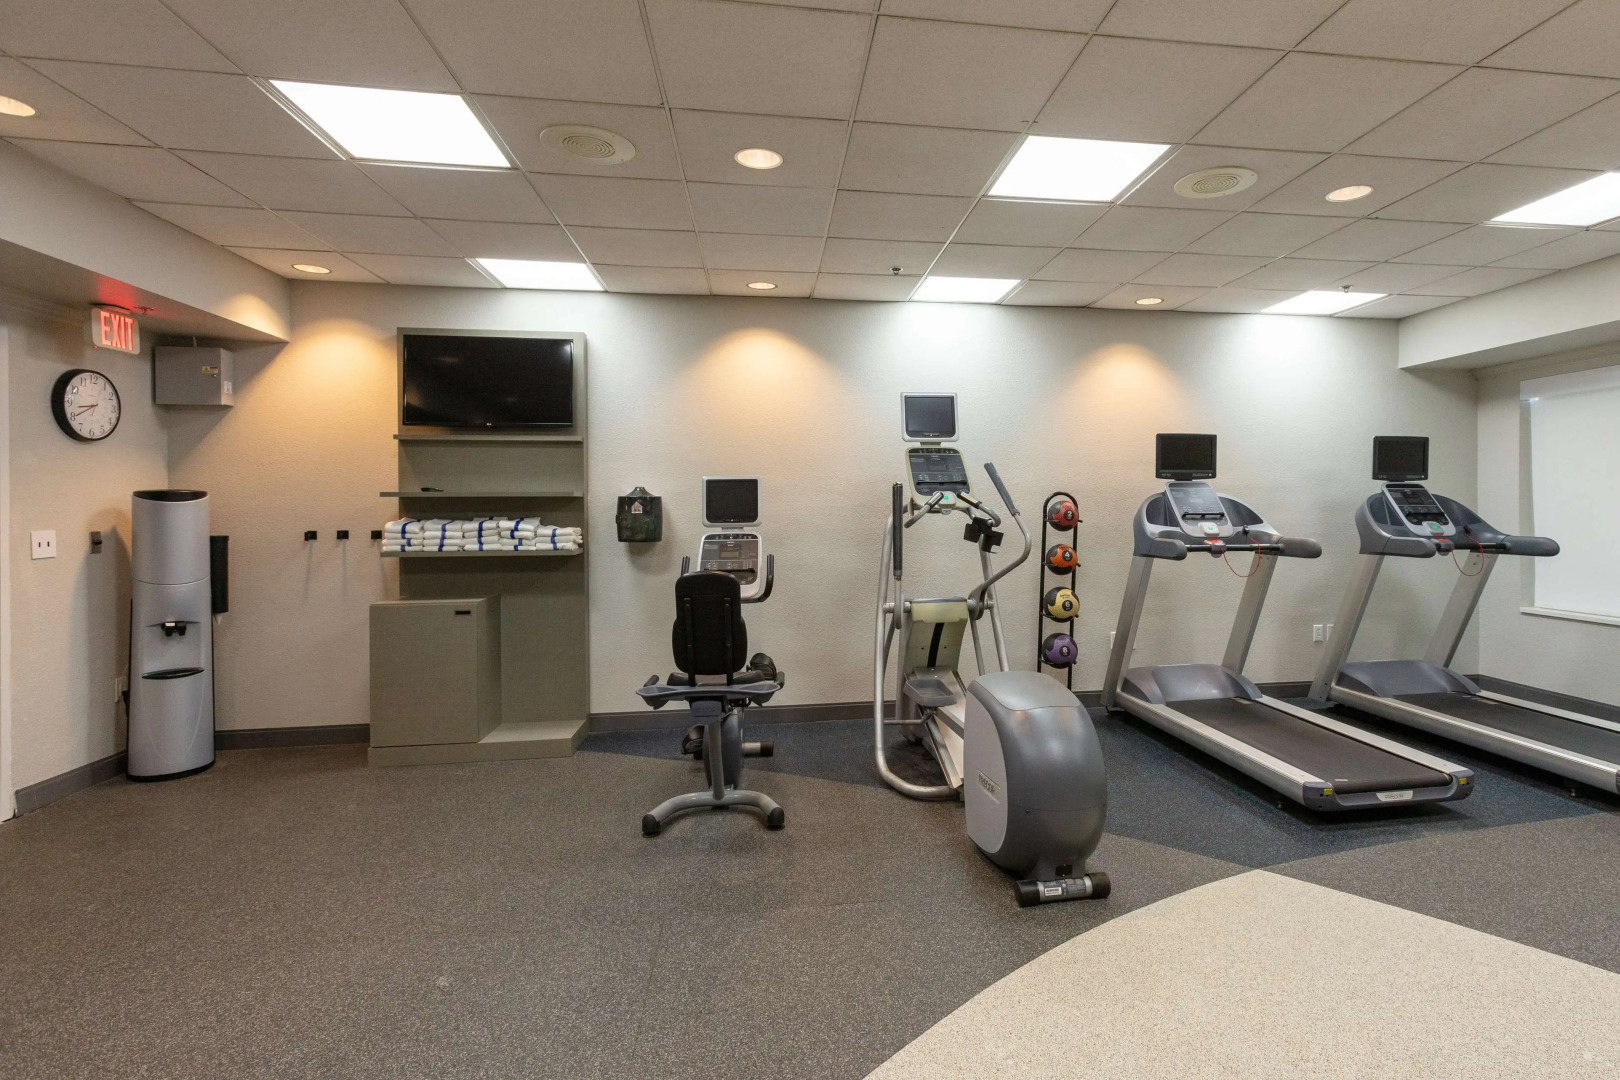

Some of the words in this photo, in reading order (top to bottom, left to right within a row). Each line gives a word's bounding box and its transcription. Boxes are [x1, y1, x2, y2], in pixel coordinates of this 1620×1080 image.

[100, 310, 134, 351] EXIT
[80, 377, 87, 388] 11
[89, 374, 99, 385] 12
[71, 384, 79, 395] 10
[103, 382, 107, 391] 1
[108, 391, 114, 401] 2
[111, 404, 117, 414] 3
[70, 411, 76, 421] 8
[107, 417, 113, 426] 4
[78, 422, 84, 432] 7
[100, 425, 105, 435] 5
[88, 428, 95, 437] 6
